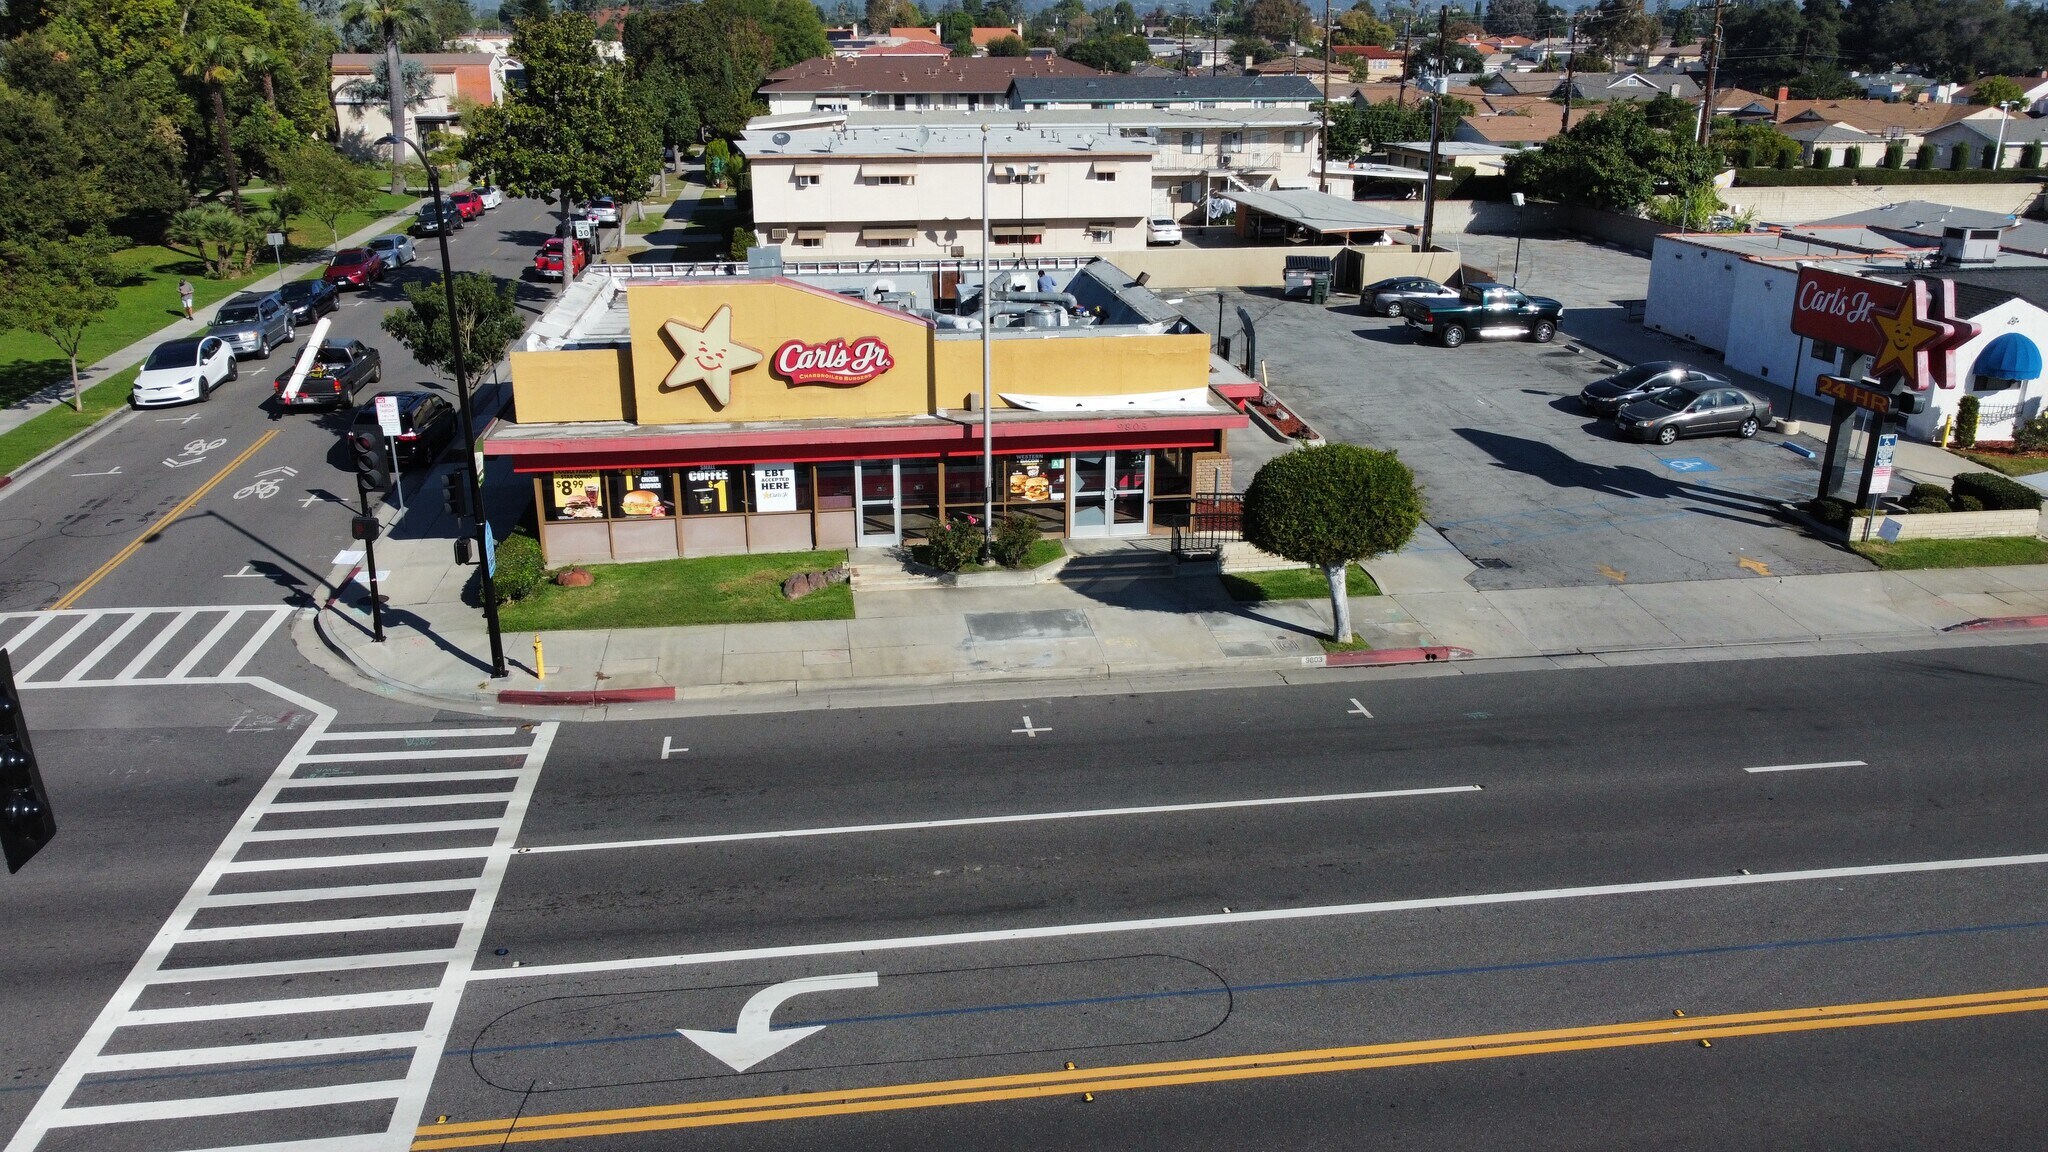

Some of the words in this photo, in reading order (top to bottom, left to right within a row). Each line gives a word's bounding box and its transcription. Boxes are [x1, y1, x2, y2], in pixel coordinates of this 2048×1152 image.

[1799, 280, 1849, 316] Carl's
[779, 342, 852, 373] Carl's
[799, 373, 844, 381] CHARBROILED
[844, 373, 872, 381] BURGERS
[1820, 380, 1847, 399] 24
[1852, 387, 1887, 411] HR
[688, 469, 729, 482] COFFEE
[764, 468, 785, 477] EBT
[761, 482, 790, 490] HERE
